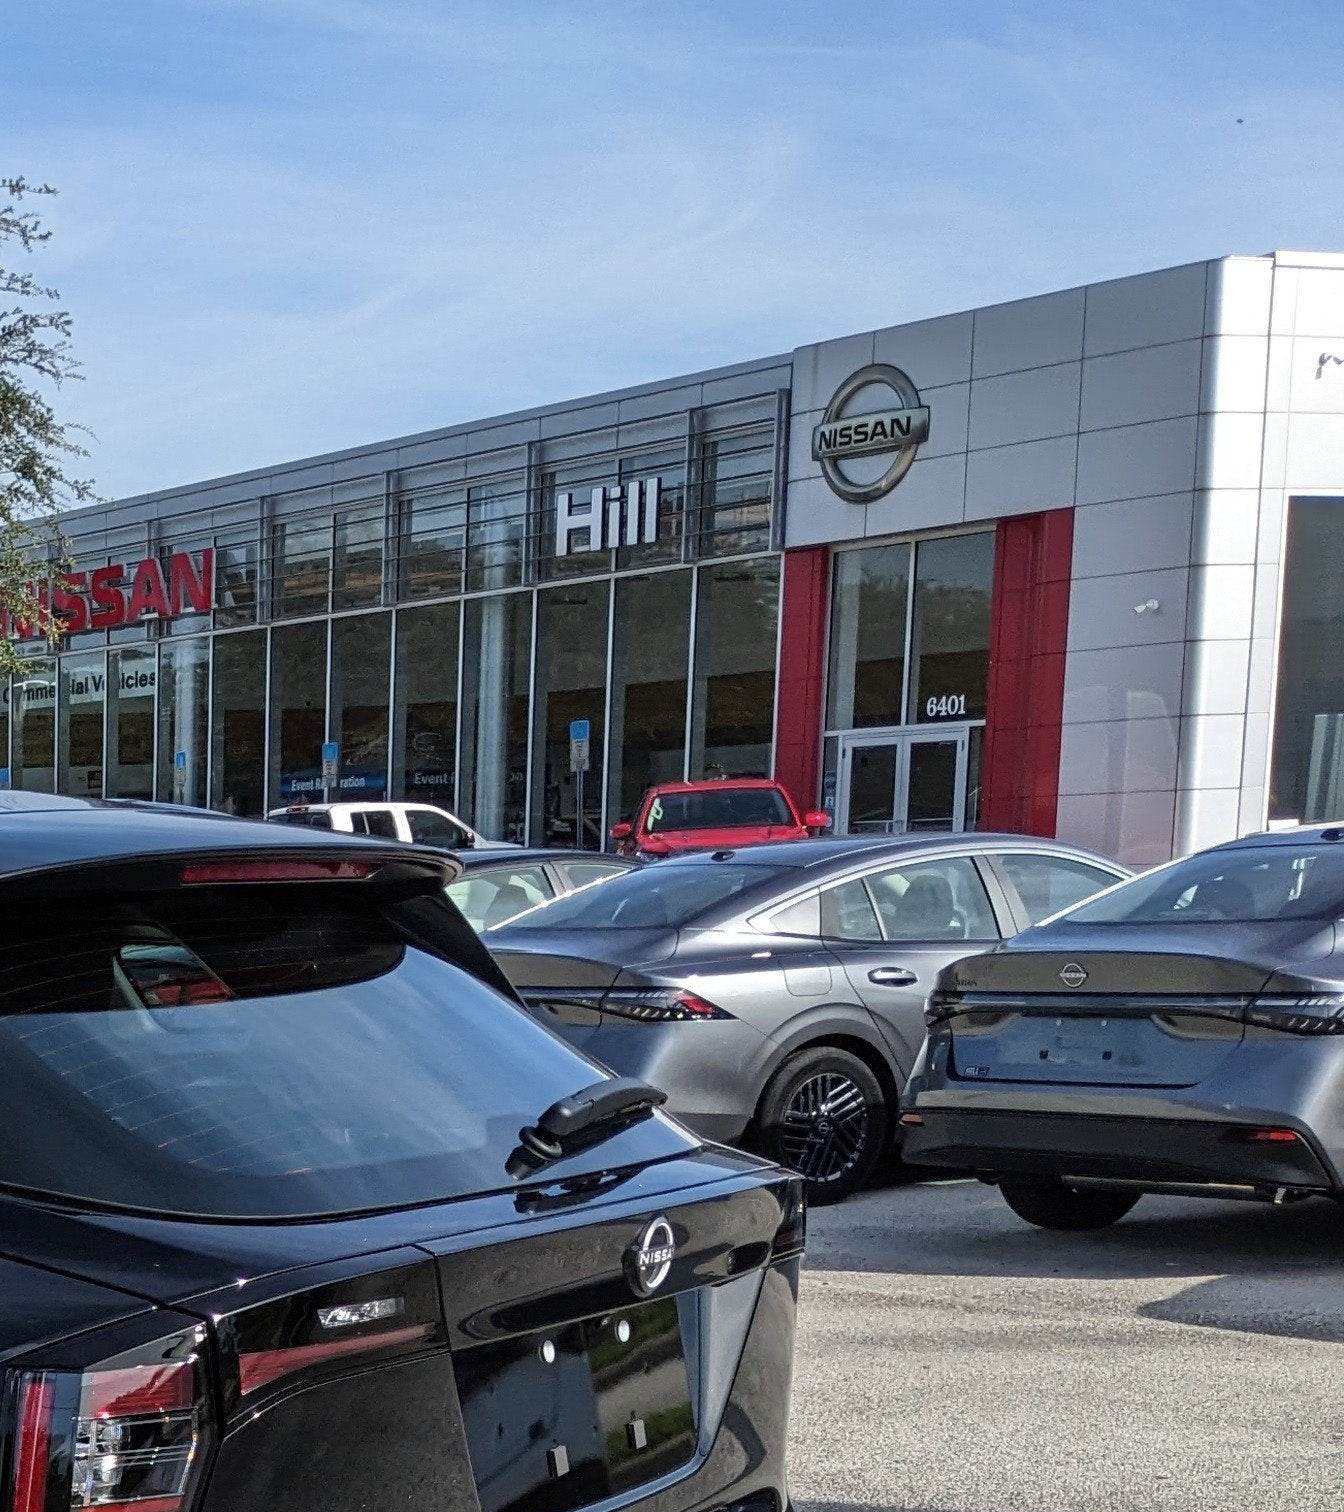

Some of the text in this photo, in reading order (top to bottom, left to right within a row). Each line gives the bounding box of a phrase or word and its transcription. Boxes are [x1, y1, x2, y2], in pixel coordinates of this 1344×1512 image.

[818, 416, 912, 452] NISSAN
[555, 477, 661, 557] Hill
[926, 694, 966, 717] 6401
[414, 772, 449, 785] Event
